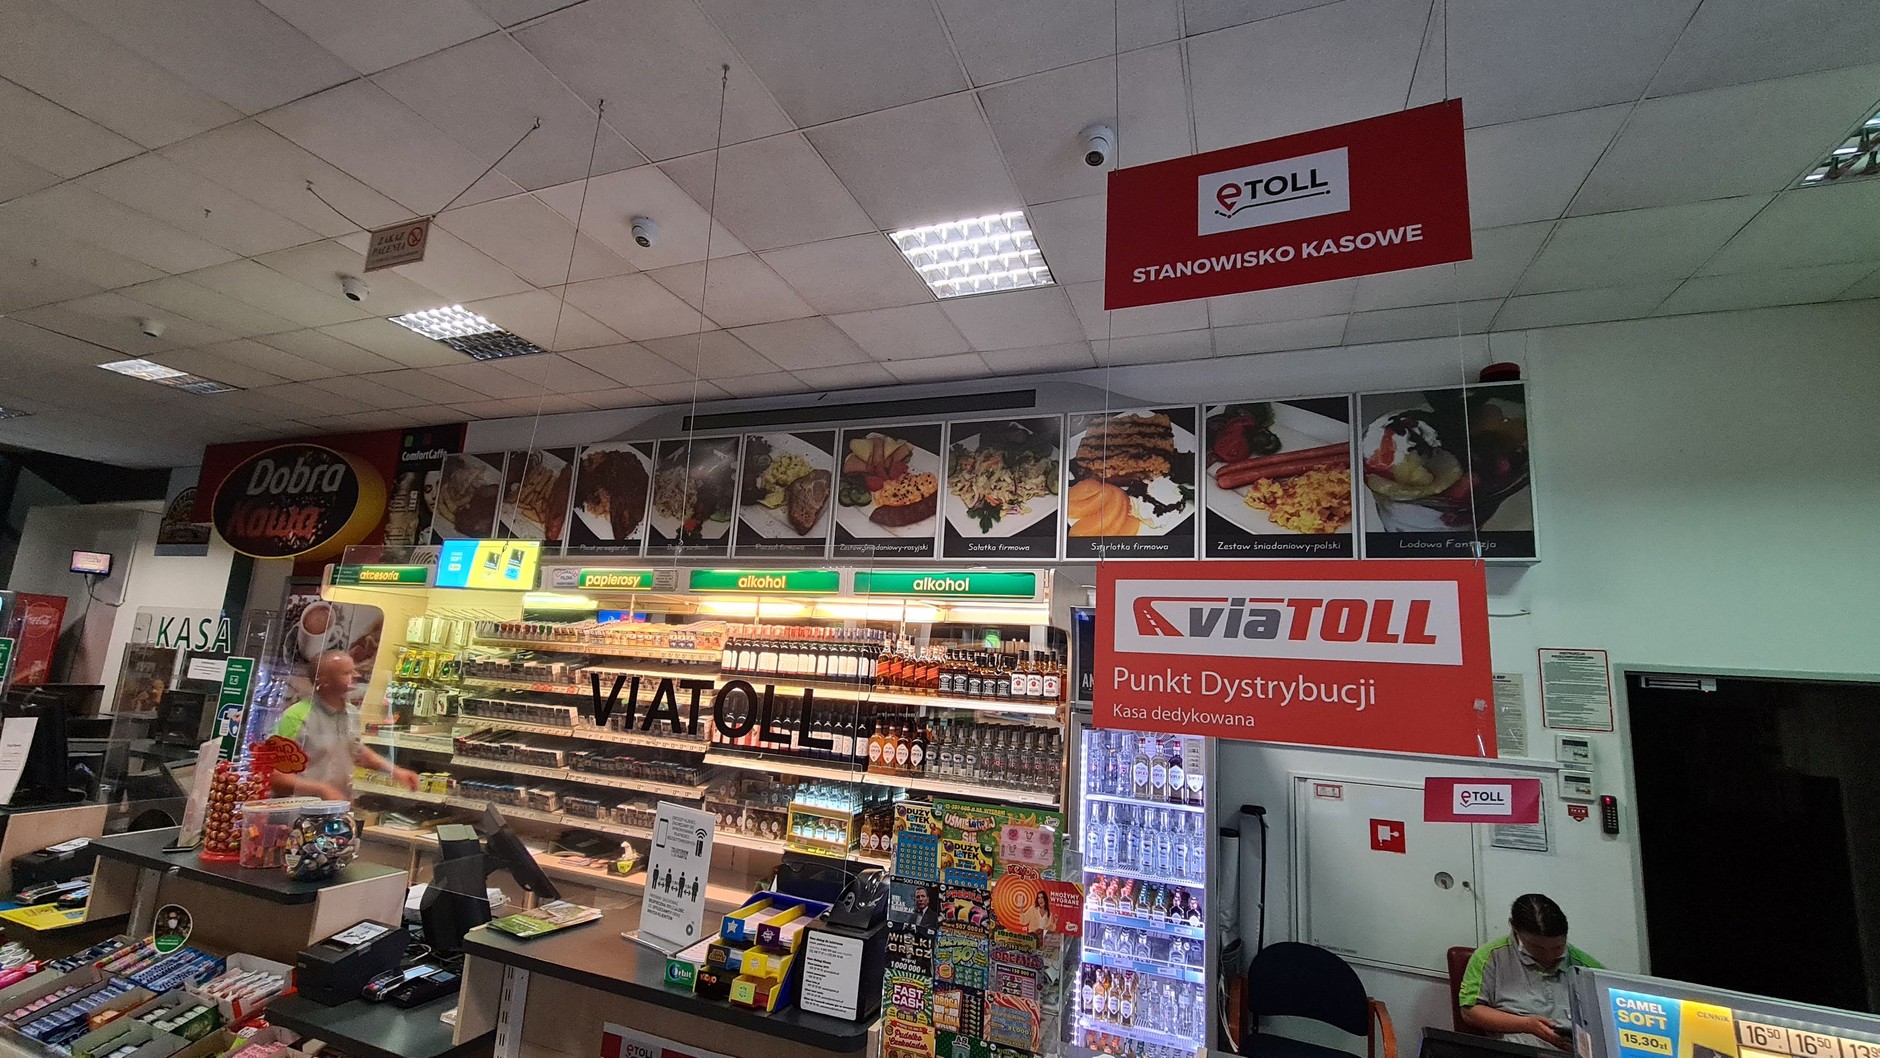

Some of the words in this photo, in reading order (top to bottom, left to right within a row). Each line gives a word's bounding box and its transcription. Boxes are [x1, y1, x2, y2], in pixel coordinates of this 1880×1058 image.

[1216, 168, 1329, 212] eTOLL
[1132, 245, 1296, 283] STANOWISKO
[1301, 223, 1424, 260] KASOWE
[246, 456, 346, 496] Dobra
[998, 543, 1030, 552] firmowa
[1133, 542, 1169, 551] firmowa
[1217, 541, 1251, 551] Zestaw
[1253, 541, 1342, 553] śniadaniowy-polski
[1399, 539, 1443, 549] Lodowa
[1445, 538, 1497, 551] Fantzja
[359, 569, 399, 581] akcesoria
[585, 573, 641, 588] papierosy
[738, 574, 786, 589] alkohol
[913, 577, 970, 592] alkohol
[1188, 597, 1438, 645] viaTOLL
[154, 616, 231, 654] KASA
[1113, 665, 1192, 695] Punkt
[1200, 670, 1377, 711] Dystrybucji
[591, 673, 834, 751] VIATOLL
[1112, 703, 1147, 720] Kasa
[1151, 707, 1256, 728] dedykowana
[1460, 790, 1504, 804] eTOLL
[906, 807, 930, 817] DUŻY
[953, 842, 980, 854] DUŻY
[1050, 891, 1080, 900] MNOŻYMY
[888, 932, 932, 949] WIELKI
[888, 943, 932, 959] GRACZ
[669, 962, 692, 980] Orbit
[894, 984, 924, 1000] FAST
[892, 994, 925, 1011] CASH
[1615, 997, 1667, 1016] CAMEL
[1617, 1009, 1668, 1031] SOFT
[1696, 1011, 1730, 1023] CENNIK
